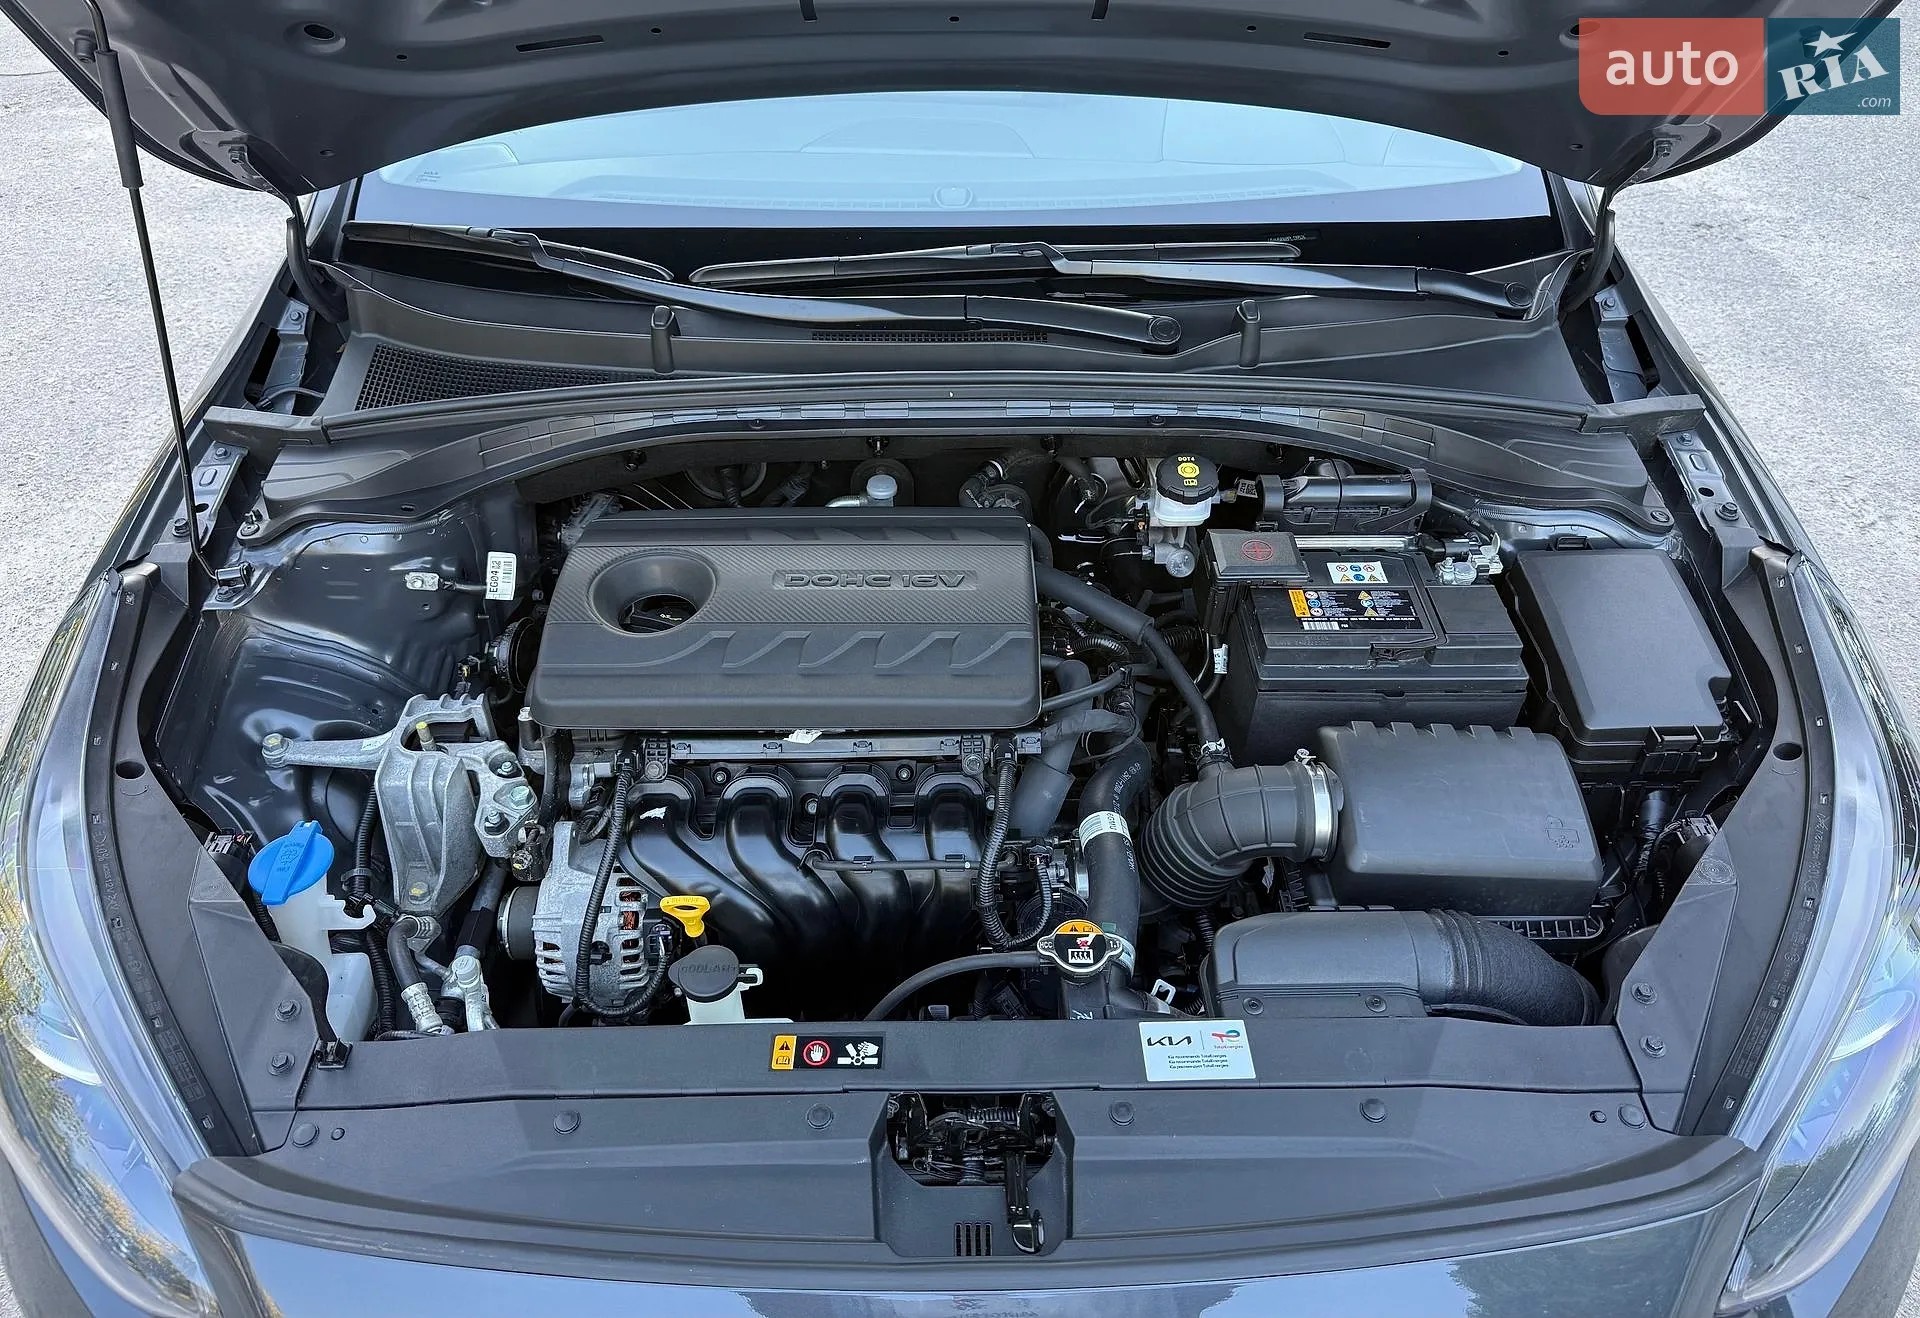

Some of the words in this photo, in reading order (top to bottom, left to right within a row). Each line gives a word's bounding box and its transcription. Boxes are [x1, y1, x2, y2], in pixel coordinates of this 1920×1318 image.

[784, 573, 892, 588] DOHC
[902, 573, 965, 588] 16V
[1040, 941, 1053, 949] HCC
[1109, 940, 1120, 948] 1.1
[1146, 1035, 1192, 1047] KIA
